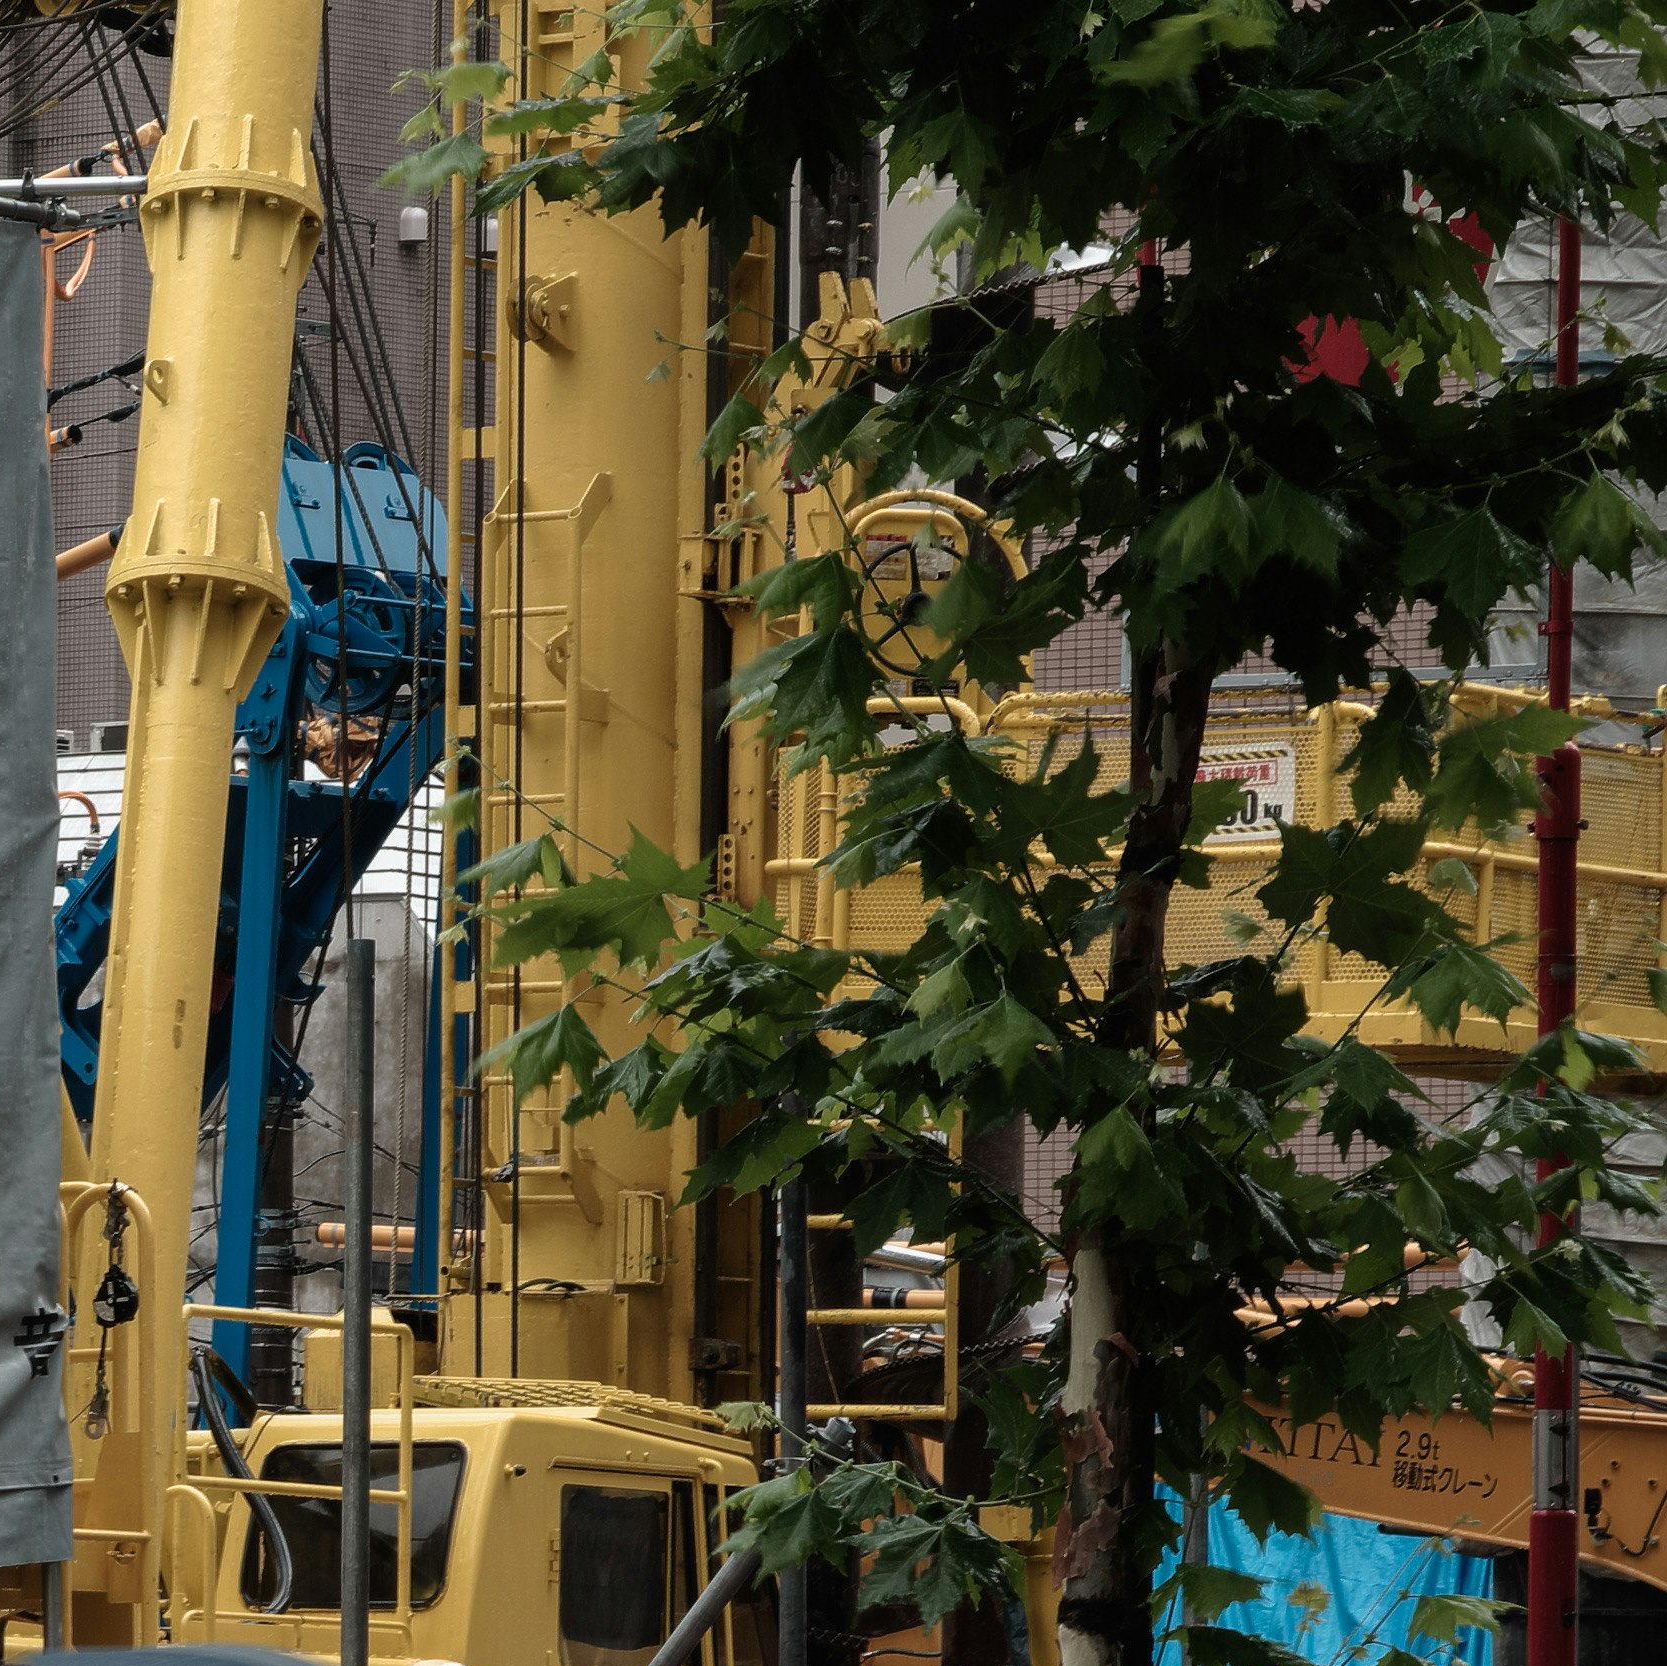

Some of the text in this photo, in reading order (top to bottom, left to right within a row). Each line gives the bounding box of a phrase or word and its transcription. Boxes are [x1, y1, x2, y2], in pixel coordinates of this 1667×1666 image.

[1392, 1460, 1499, 1499] 移動式クレーン
